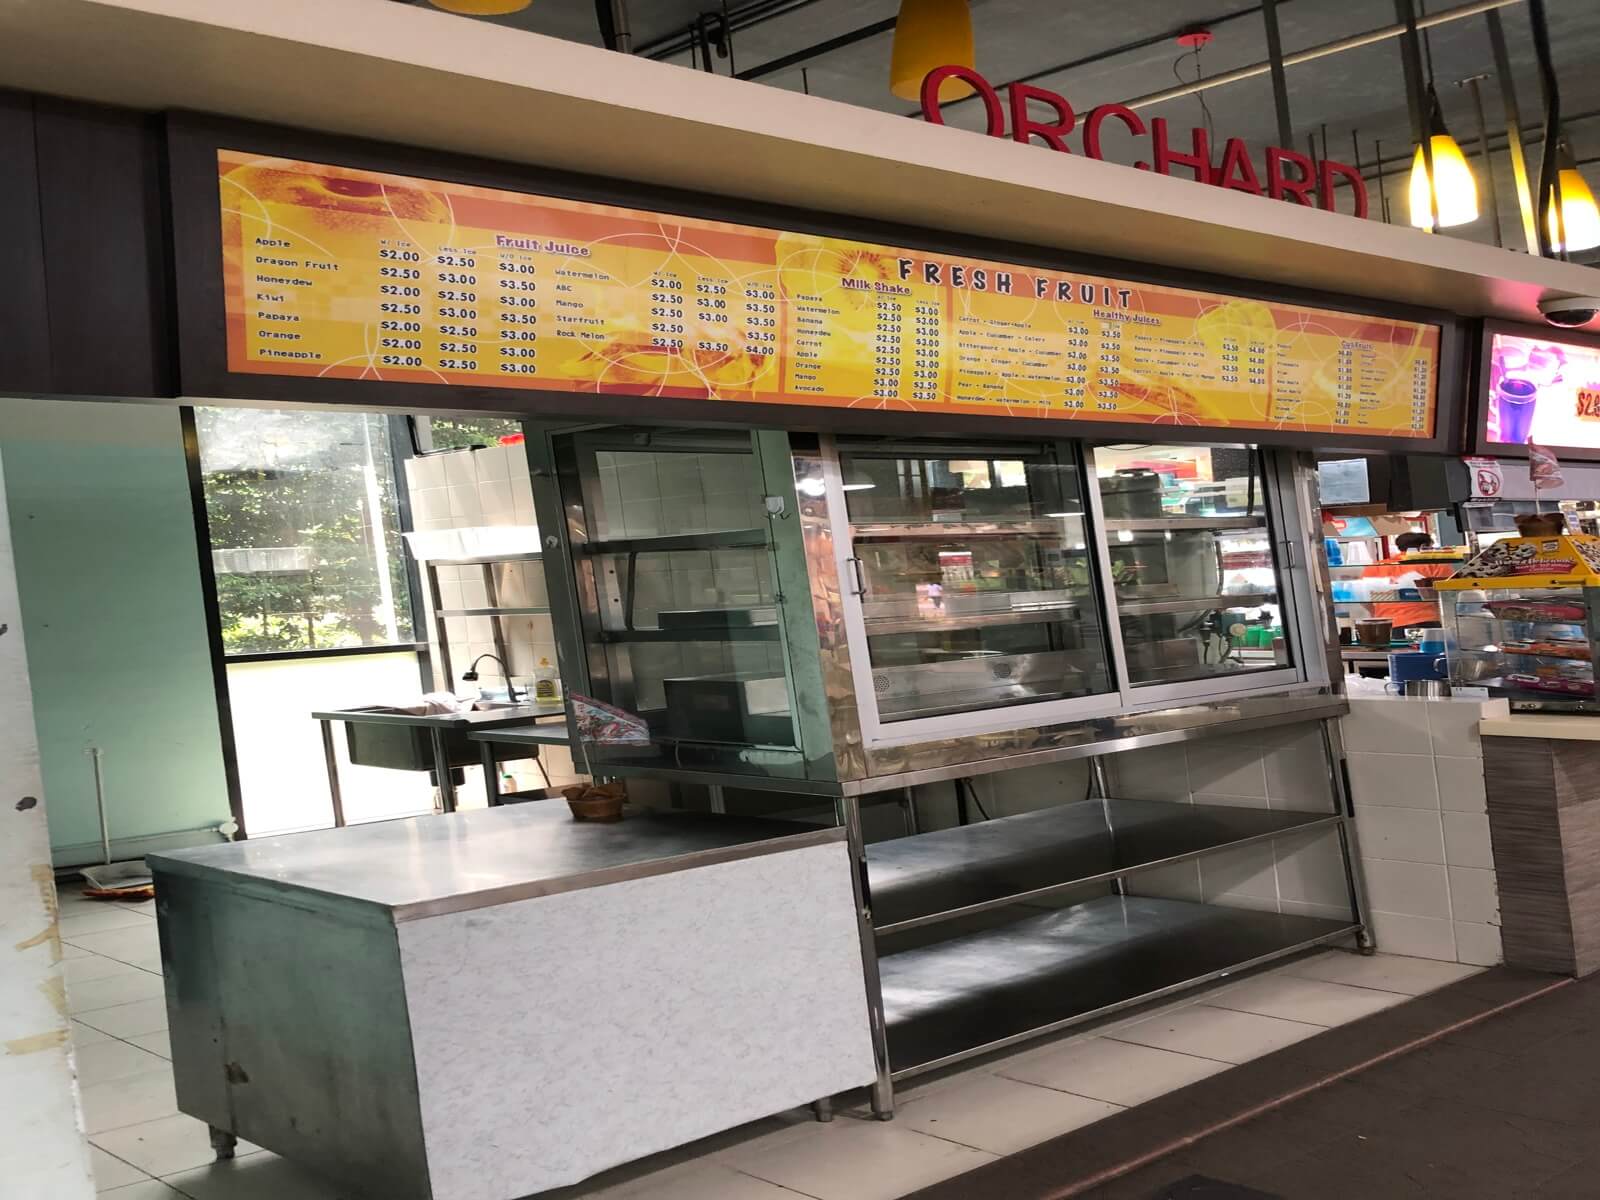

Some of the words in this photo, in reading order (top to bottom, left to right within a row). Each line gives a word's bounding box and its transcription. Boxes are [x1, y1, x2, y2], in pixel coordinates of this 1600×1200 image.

[921, 65, 1368, 219] ORCHARD
[256, 238, 291, 248] Apple
[380, 250, 419, 261] $2.00
[438, 256, 475, 267] $2.50
[499, 262, 534, 274] $3.00
[496, 235, 540, 250] Fruit
[545, 243, 589, 256] Juice
[256, 257, 298, 268] Dragon
[305, 261, 339, 271] Fruit
[380, 267, 420, 279] $2.50
[439, 273, 476, 285] $3.00
[500, 280, 536, 291] $3.50
[842, 278, 871, 290] Milk
[875, 282, 910, 294] Shake
[898, 259, 1012, 293] FRESH
[1036, 278, 1131, 308] FRUIT
[256, 275, 312, 287] Honeydew
[381, 285, 420, 297] $2.00
[438, 291, 475, 302] $2.50
[500, 296, 535, 308] $3.00
[651, 279, 682, 290] $2.00
[697, 284, 726, 294] $2.50
[746, 290, 775, 300] $3.00
[652, 293, 683, 304] $2.50
[697, 298, 726, 308] $3.00
[746, 304, 775, 313] $3.50
[257, 294, 284, 302] Kiwi
[381, 303, 420, 314] $2.50
[440, 308, 476, 319] $3.00
[501, 314, 536, 324] $3.50
[556, 300, 584, 309] Mango
[652, 308, 682, 318] $2.50
[699, 313, 727, 322] $3.00
[747, 318, 775, 327] $3.50
[1094, 309, 1130, 322] Healthy
[1133, 314, 1160, 326] Juices
[258, 312, 300, 323] Papaya
[381, 321, 420, 332] $2.00
[440, 326, 477, 337] $2.50
[501, 331, 536, 341] $3.00
[557, 315, 604, 325] Starfruit
[652, 323, 683, 333] $2.50
[748, 332, 775, 341] $3.50
[258, 331, 300, 341] Orange
[382, 339, 421, 349] $2.00
[440, 343, 477, 353] $2.50
[501, 348, 535, 358] $3.00
[557, 330, 576, 338] Rock
[581, 332, 605, 340] Melon
[653, 338, 683, 348] $2.50
[699, 342, 728, 351] $3.50
[746, 345, 774, 355] $4.00
[259, 349, 321, 361] Pineapple
[383, 355, 422, 366] $2.00
[440, 360, 476, 370] $2.50
[501, 364, 535, 373] $3.00
